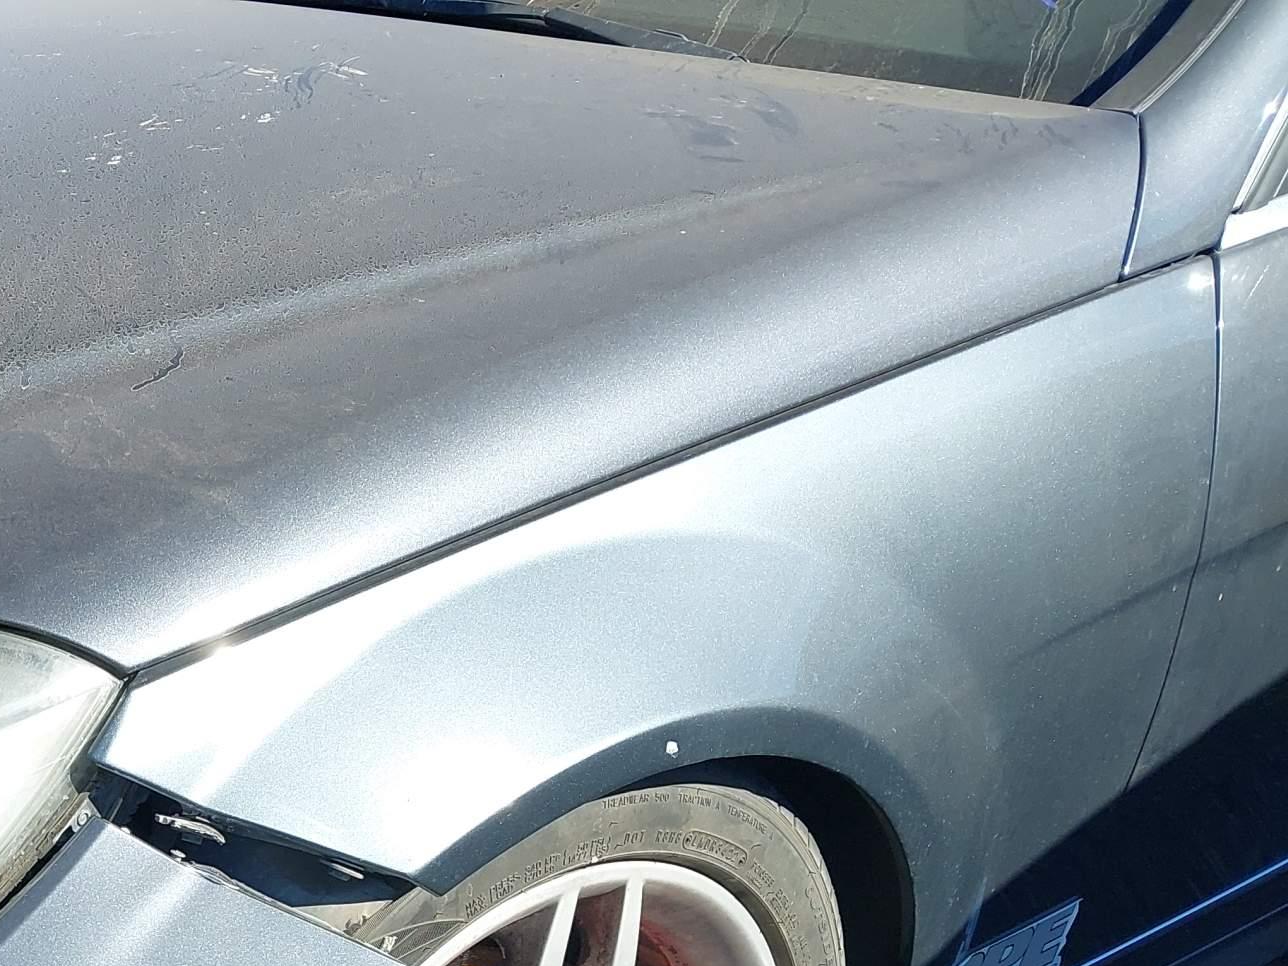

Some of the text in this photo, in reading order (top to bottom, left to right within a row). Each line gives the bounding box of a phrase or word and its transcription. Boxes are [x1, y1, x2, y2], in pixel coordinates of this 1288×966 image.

[603, 793, 650, 809] TREADWEAR
[654, 793, 670, 803] 500
[678, 793, 712, 808] TRACTION
[727, 805, 769, 835] TEMPERATURE
[623, 830, 646, 845] DOT
